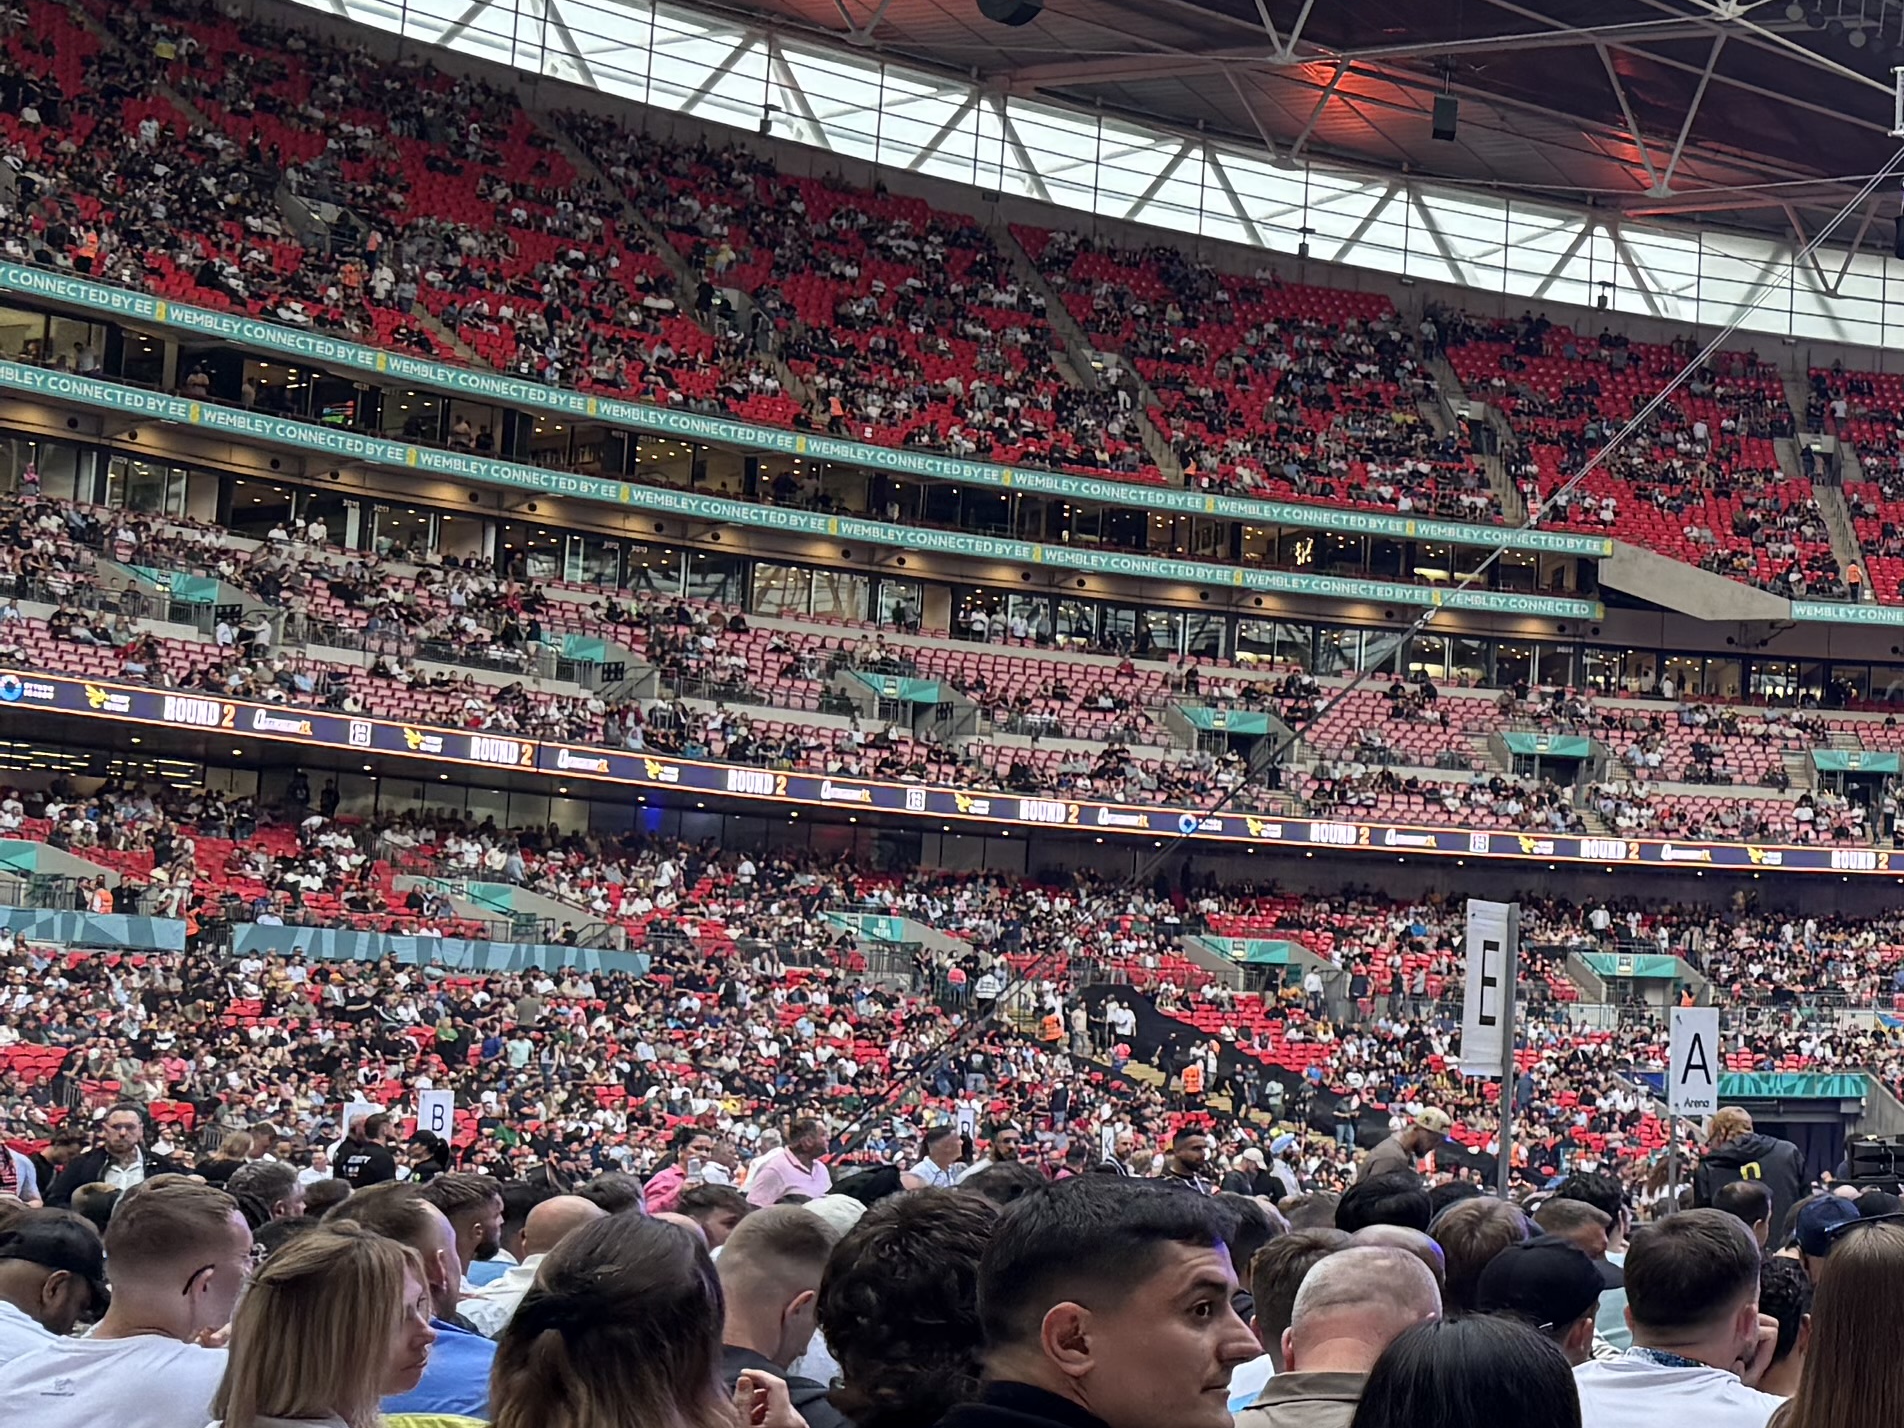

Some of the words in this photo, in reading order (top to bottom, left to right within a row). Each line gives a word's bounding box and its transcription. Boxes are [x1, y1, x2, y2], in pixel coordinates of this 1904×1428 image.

[8, 267, 108, 305] CONNECTED
[111, 293, 132, 311] BY
[134, 298, 152, 315] EE
[170, 307, 242, 336] WEMBLEY
[243, 324, 334, 356] CONNECTED
[336, 346, 354, 361] BY
[358, 350, 373, 365] EE
[48, 376, 142, 408] CONNECTED
[146, 397, 166, 413] BY
[169, 402, 186, 417] EE
[388, 358, 454, 383] WEMBLEY
[458, 373, 546, 402] CONNECTED
[550, 392, 567, 406] BY
[569, 396, 584, 410] EE
[204, 409, 273, 435] WEMBLEY
[276, 424, 363, 452] CONNECTED
[366, 442, 384, 456] BY
[387, 446, 404, 460] EE
[600, 402, 668, 426] WEMBLEY
[669, 415, 754, 441] CONNECTED
[757, 431, 774, 445] BY
[776, 434, 793, 448] EE
[420, 452, 488, 476] WEMBLEY
[490, 465, 576, 491] CONNECTED
[579, 481, 598, 495] BY
[600, 484, 616, 498] EE
[808, 440, 875, 462] WEMBLEY
[876, 451, 960, 475] CONNECTED
[962, 465, 982, 478] BY
[983, 468, 998, 481] EE
[1014, 473, 1079, 493] WEMBLEY
[1081, 482, 1165, 504] CONNECTED
[1167, 494, 1186, 507] BY
[1187, 497, 1201, 509] EE
[632, 490, 698, 511] WEMBLEY
[700, 501, 786, 525] CONNECTED
[788, 514, 808, 528] BY
[810, 518, 824, 531] EE
[1218, 501, 1282, 519] WEMBLEY
[1282, 509, 1366, 528] CONNECTED
[1368, 519, 1386, 531] BY
[1388, 521, 1402, 532] EE
[841, 522, 905, 542] WEMBLEY
[908, 532, 992, 554] CONNECTED
[994, 543, 1012, 556] BY
[1014, 546, 1029, 558] EE
[1418, 524, 1480, 540] WEMBLEY
[1567, 539, 1584, 550] BY
[1586, 540, 1600, 551] EE
[1046, 550, 1106, 568] WEMBLEY
[1110, 558, 1194, 578] CONNECTED
[1196, 568, 1214, 580] BY
[1216, 570, 1230, 582] EE
[1246, 573, 1309, 590] WEMBLEY
[1311, 580, 1393, 598] CONNECTED
[1395, 588, 1412, 600] BY
[1414, 590, 1428, 602] EE
[1508, 598, 1590, 615] CONNECTED
[1794, 605, 1855, 619] WEMBLEY
[164, 694, 220, 727] ROUND
[222, 703, 236, 729] 2
[470, 737, 518, 765] ROUND
[520, 743, 533, 767] 2
[727, 770, 774, 795] ROUND
[775, 775, 788, 796] 2
[1018, 800, 1066, 823] ROUND
[1068, 804, 1080, 824] 2
[1479, 940, 1500, 1026] E
[1681, 1032, 1712, 1085] A
[432, 1104, 444, 1131] B
[1684, 1097, 1710, 1108] Arena
